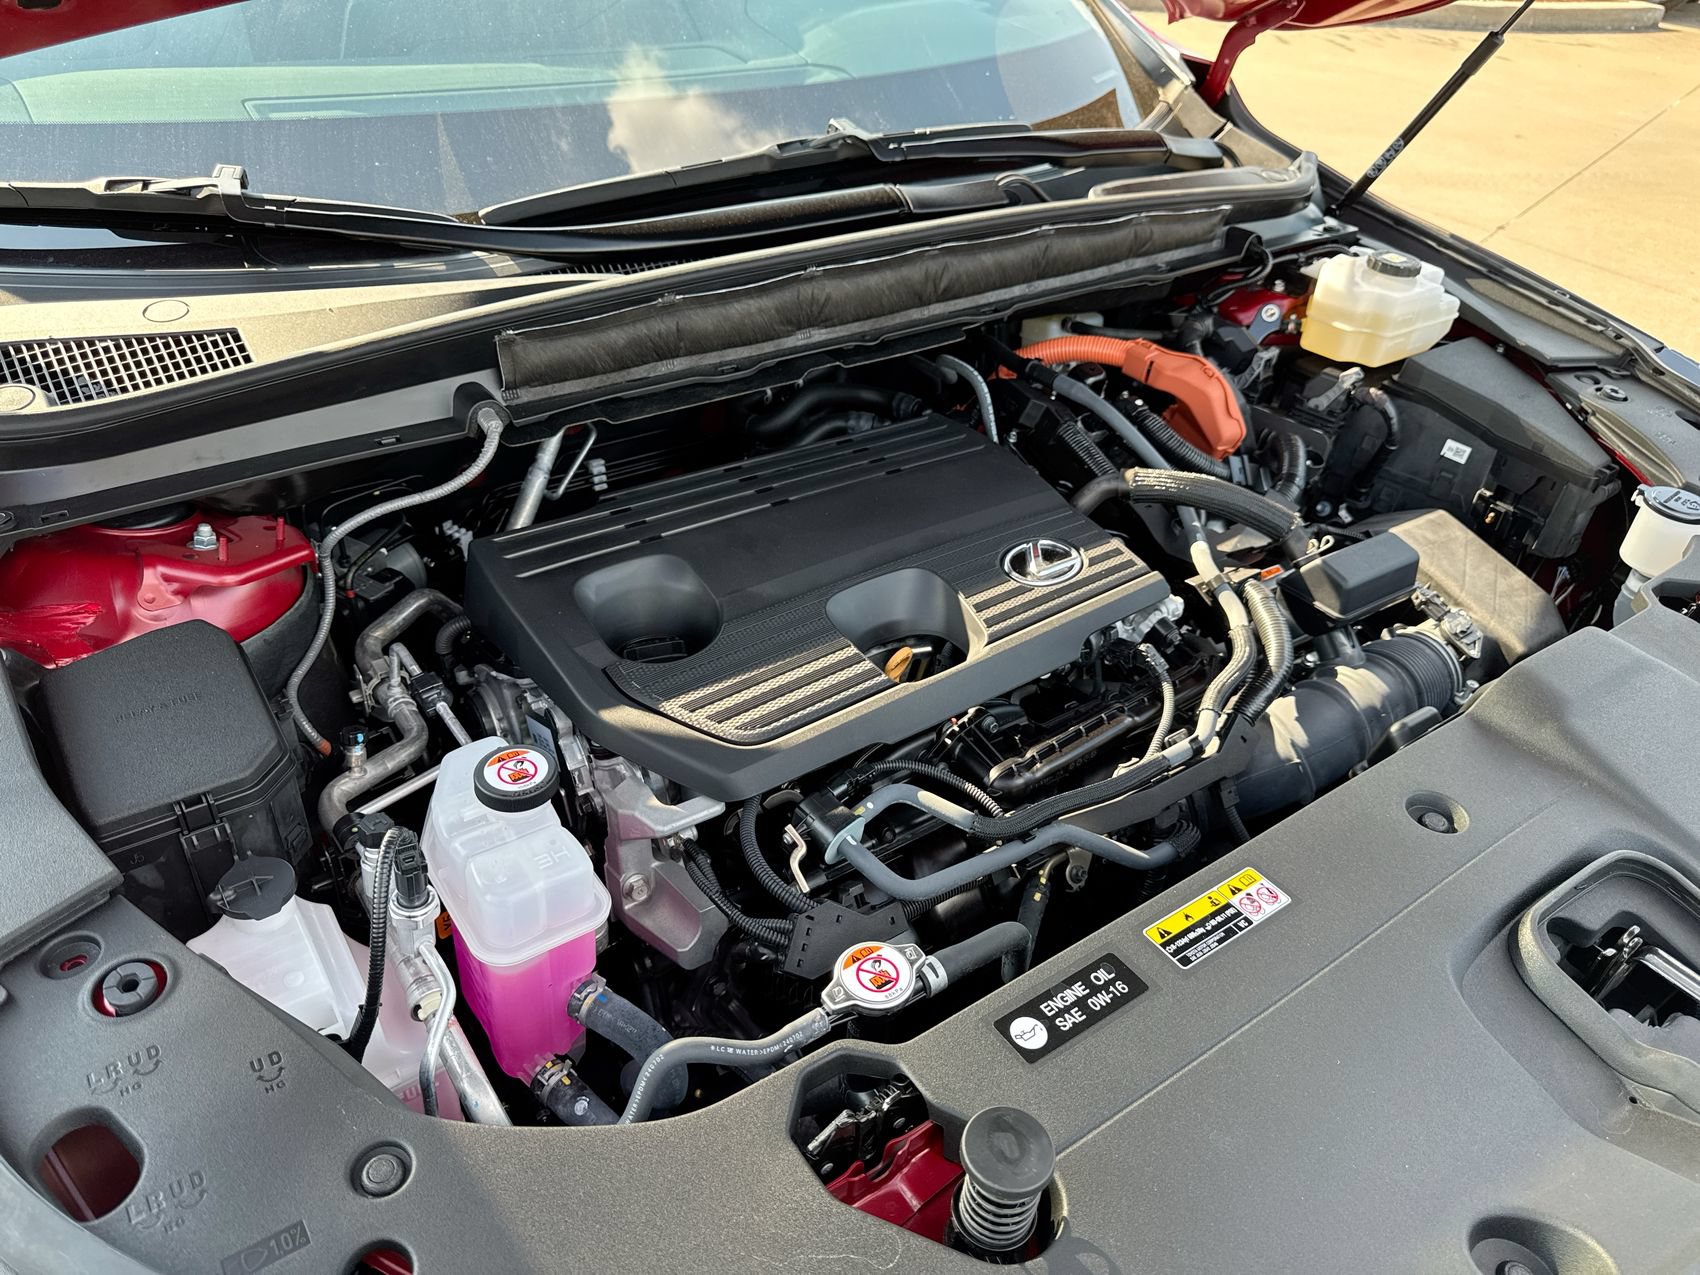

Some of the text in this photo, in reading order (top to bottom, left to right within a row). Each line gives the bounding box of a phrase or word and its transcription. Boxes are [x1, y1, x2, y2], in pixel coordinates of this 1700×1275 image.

[1040, 968, 1116, 1016] ENGINE OIL
[1055, 981, 1129, 1031] SAE 0W-16
